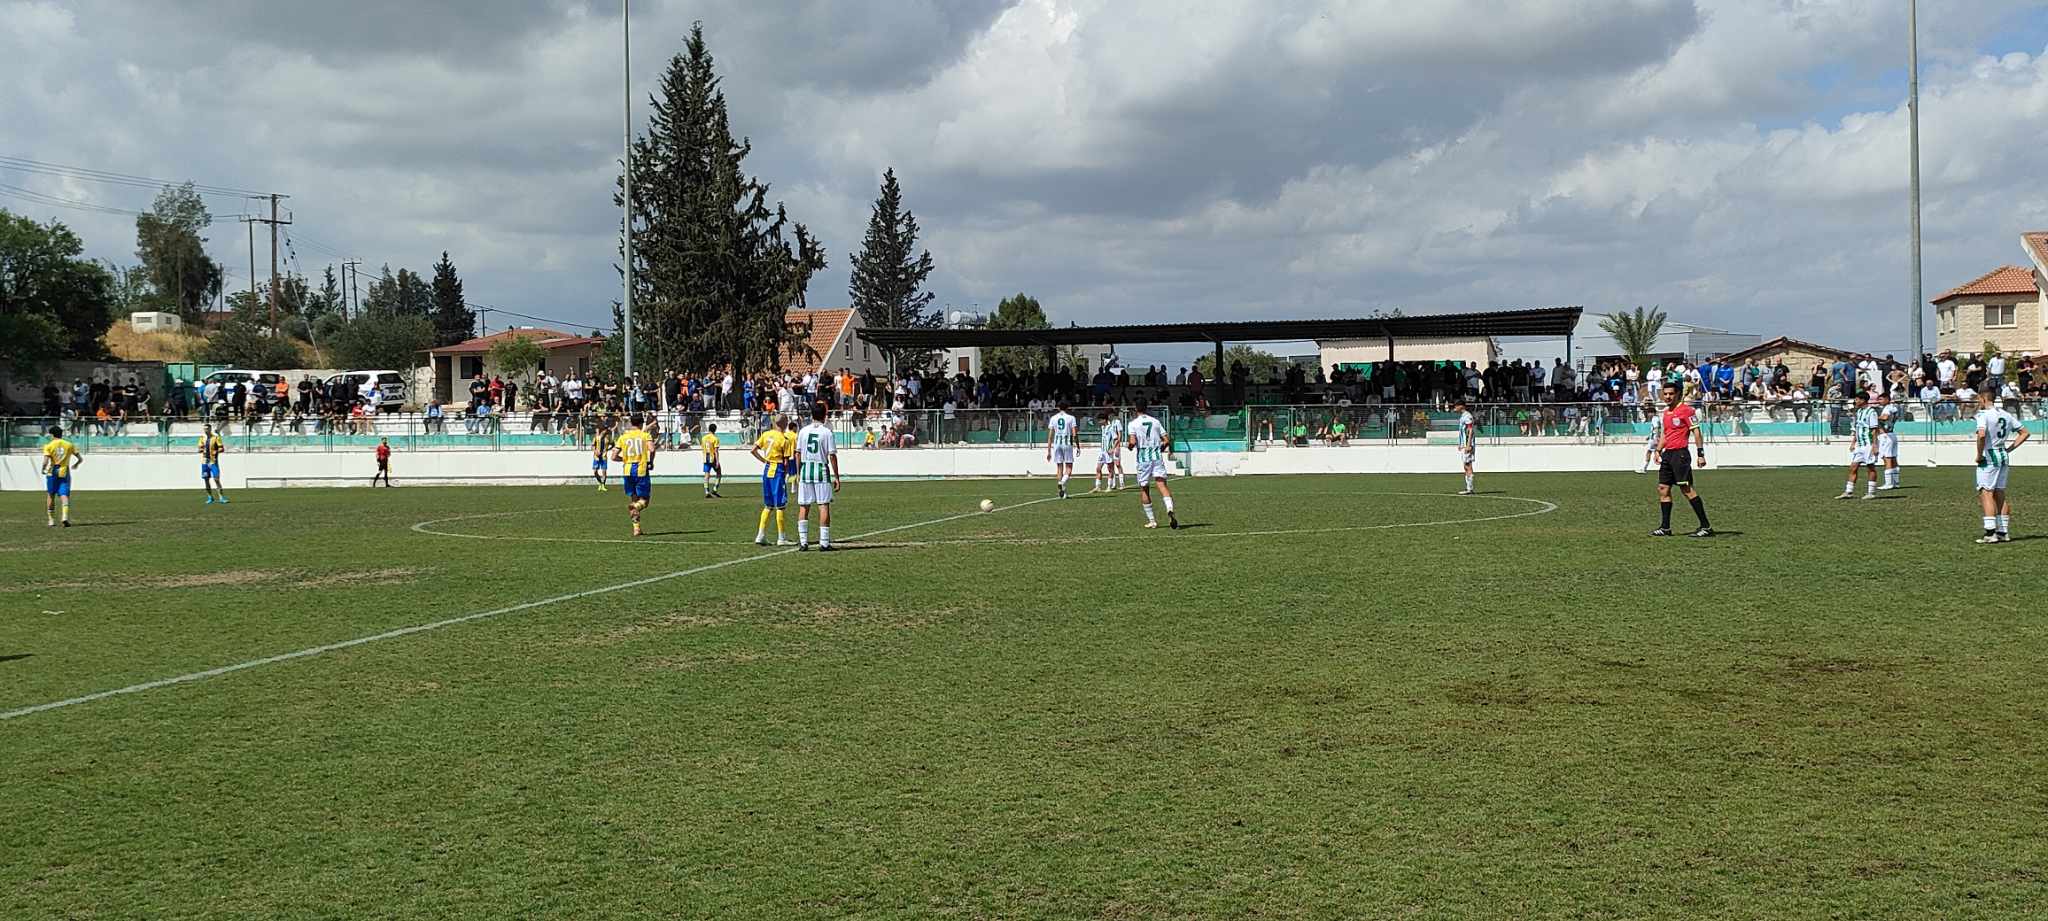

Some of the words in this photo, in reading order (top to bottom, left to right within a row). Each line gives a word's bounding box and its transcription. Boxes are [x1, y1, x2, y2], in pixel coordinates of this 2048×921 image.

[1057, 417, 1065, 431] 9
[1142, 422, 1153, 440] 7
[1997, 417, 2007, 439] 3
[625, 438, 643, 457] 20
[765, 437, 775, 457] 7
[807, 433, 819, 454] 5
